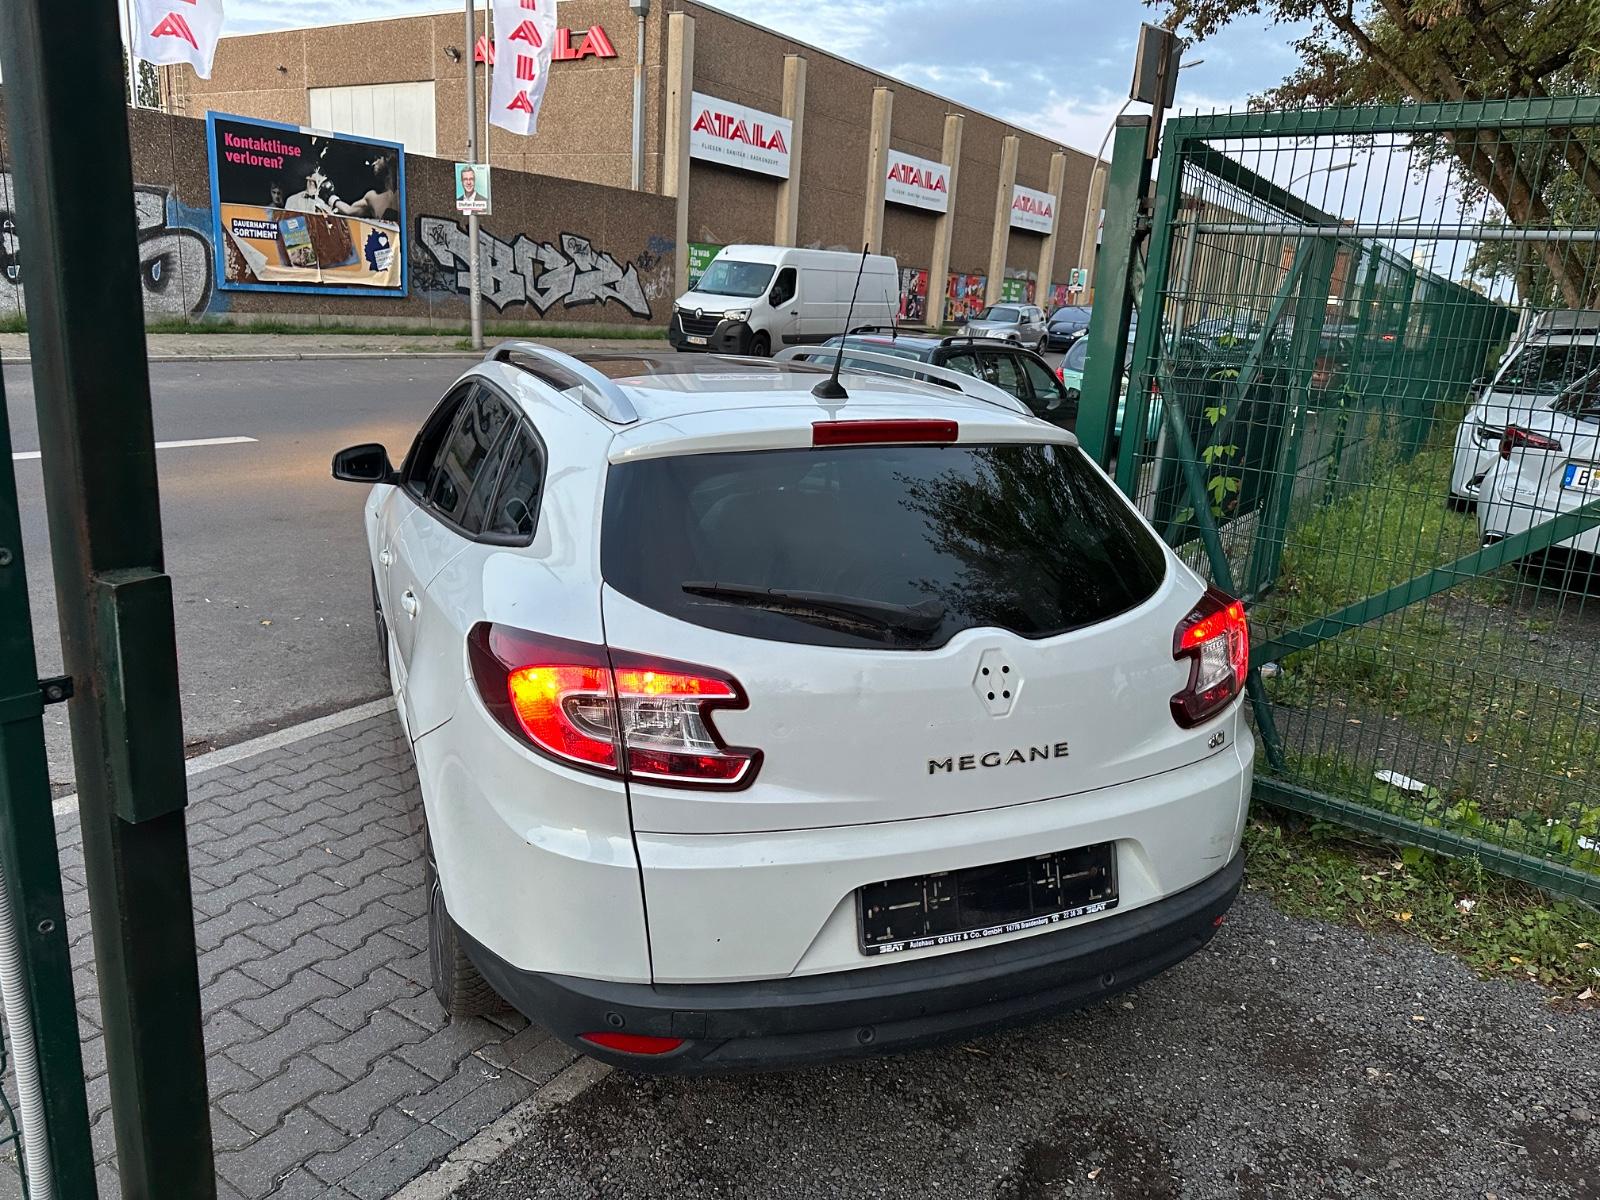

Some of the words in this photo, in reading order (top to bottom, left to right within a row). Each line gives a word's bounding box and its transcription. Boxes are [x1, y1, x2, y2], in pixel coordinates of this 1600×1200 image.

[692, 109, 788, 154] ATALA
[224, 132, 302, 157] Kontaktlinse
[225, 151, 284, 169] verloren?
[888, 162, 947, 193] ATALA
[1012, 194, 1053, 219] ATALA
[233, 219, 268, 230] DAUERHAFT
[269, 222, 278, 230] IM
[233, 228, 278, 239] SORTIMENT
[928, 741, 1070, 775] MEGANE
[879, 943, 905, 954] SEAT
[909, 939, 935, 949] Autohaus
[937, 934, 962, 944] GENTZ
[969, 931, 982, 939] Co.
[982, 927, 1003, 937] GmbH
[1086, 902, 1107, 914] SEAT
